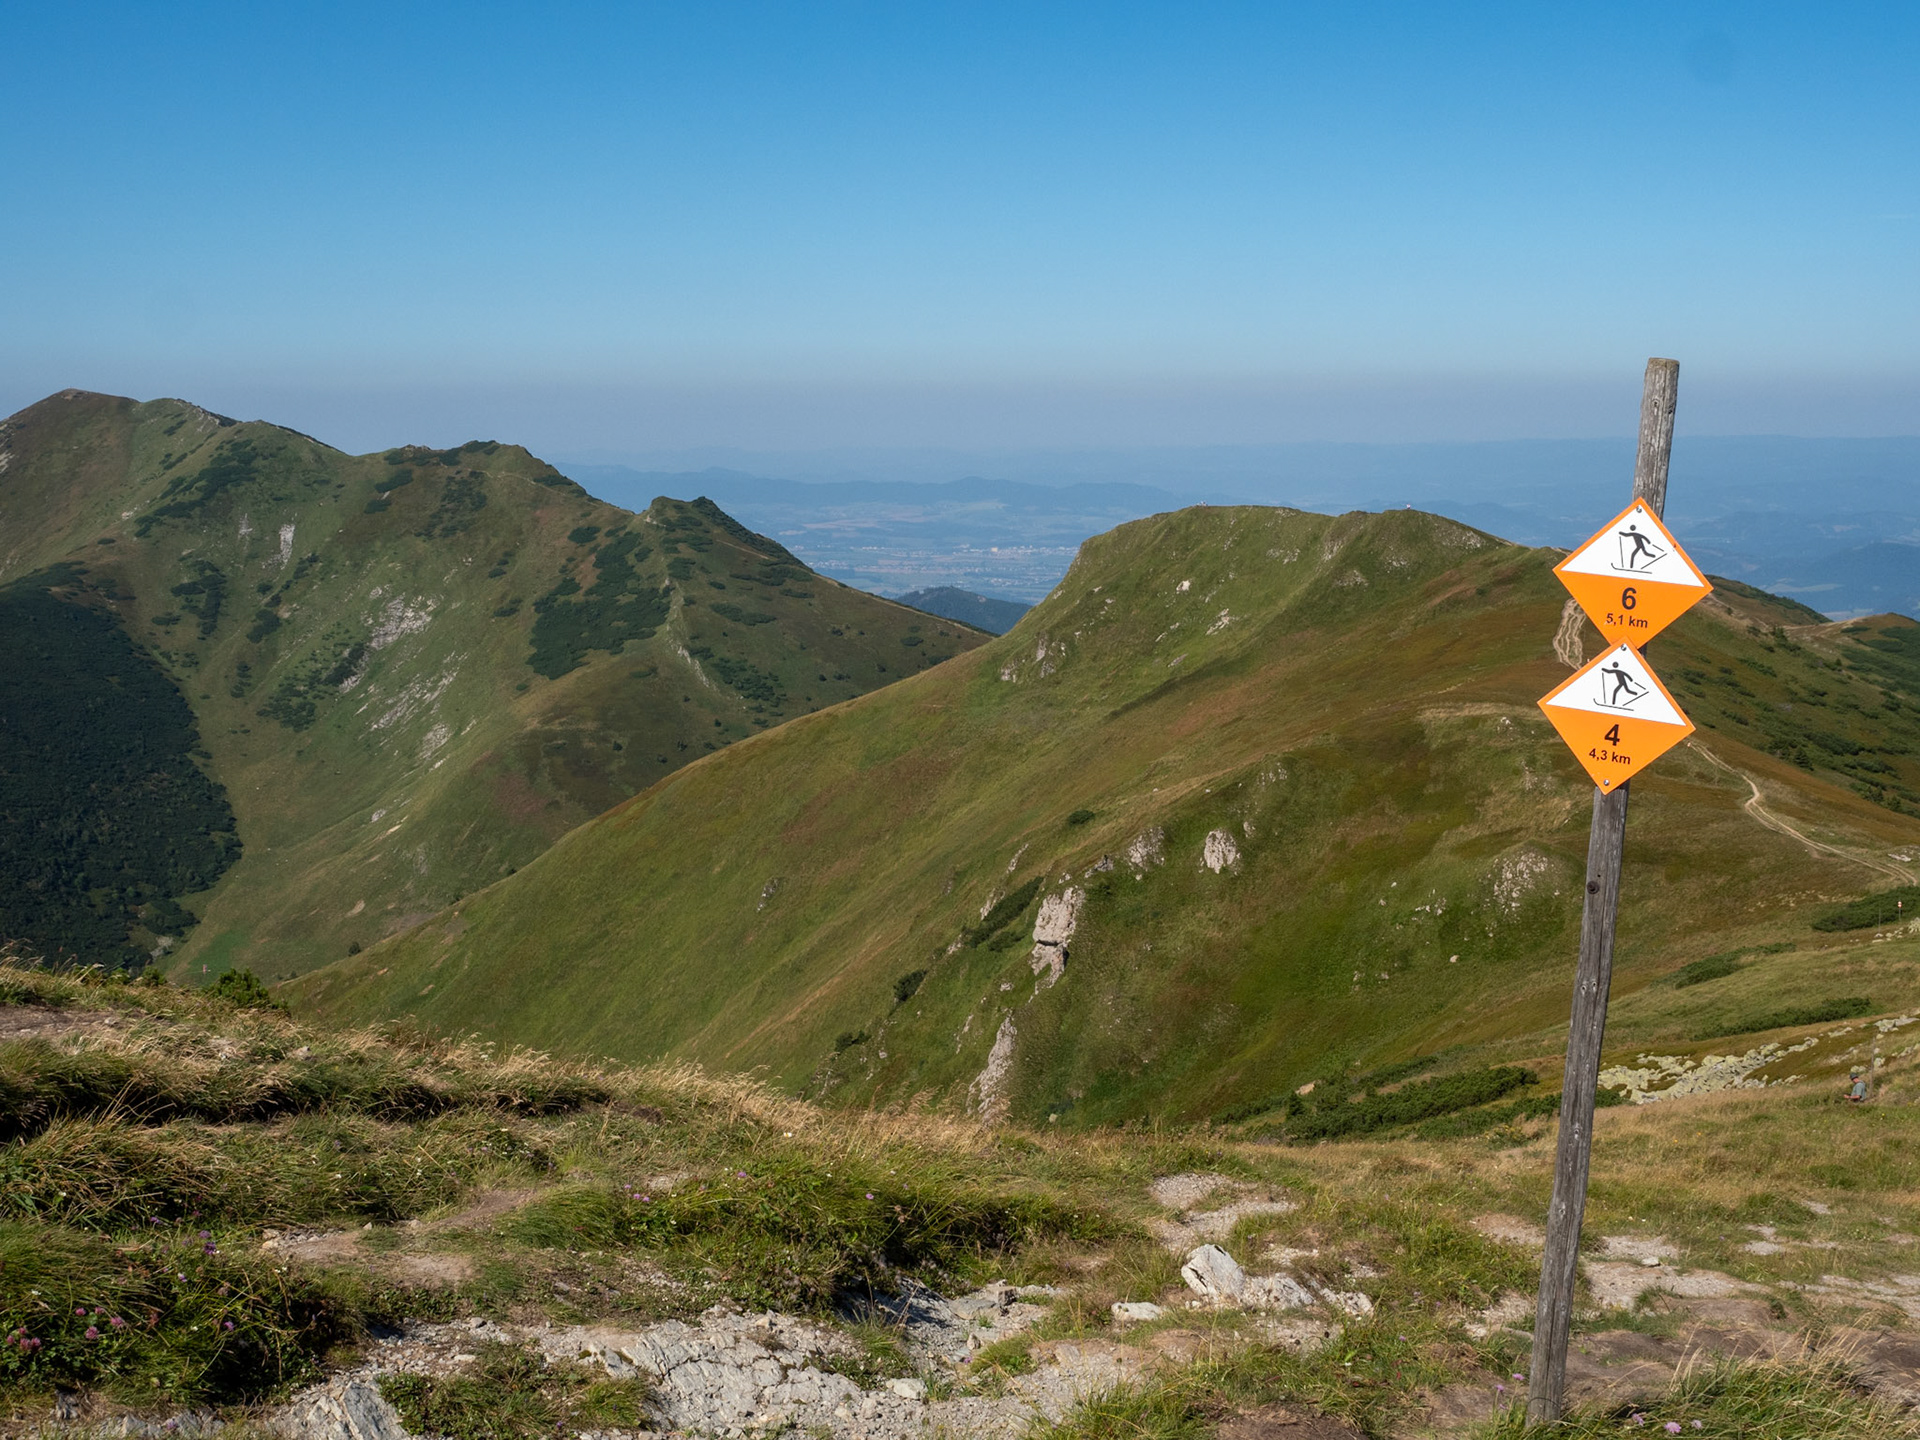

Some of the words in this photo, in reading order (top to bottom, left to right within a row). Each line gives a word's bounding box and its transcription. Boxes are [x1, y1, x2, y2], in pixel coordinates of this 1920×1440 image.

[1621, 587, 1637, 610] 6
[1606, 613, 1624, 626] 5,1
[1629, 615, 1648, 628] km
[1604, 724, 1620, 746] 4
[1589, 748, 1608, 761] 4,3
[1612, 752, 1631, 765] km
